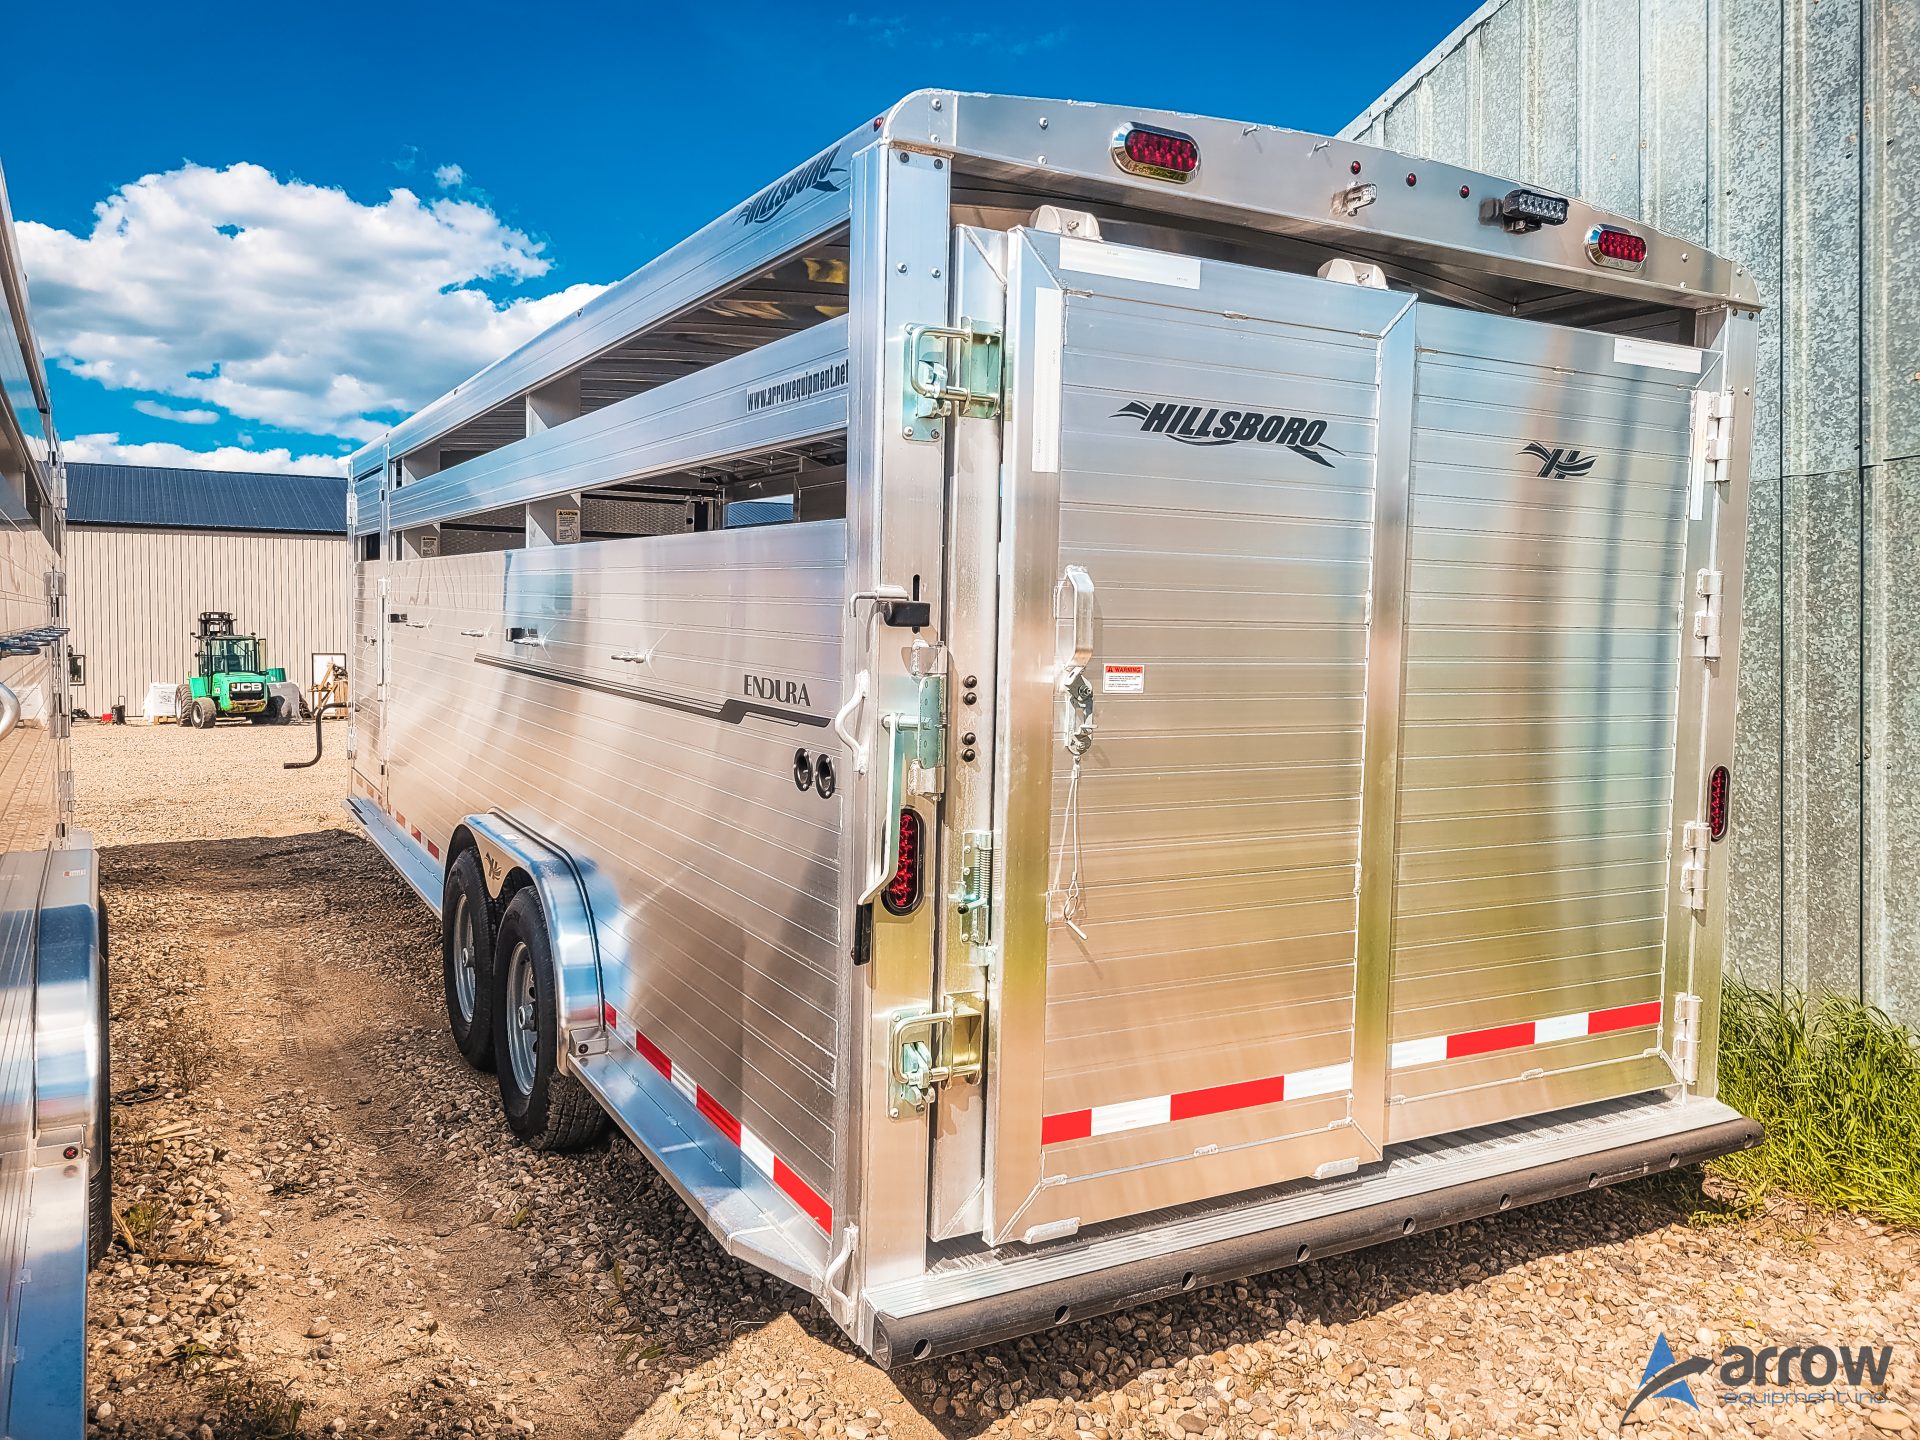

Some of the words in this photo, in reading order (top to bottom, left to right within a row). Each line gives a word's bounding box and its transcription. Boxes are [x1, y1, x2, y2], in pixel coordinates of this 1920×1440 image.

[747, 359, 849, 412] www.arrowequipment.net
[1140, 402, 1328, 447] HILLSBORO
[231, 683, 263, 691] JCB
[743, 674, 811, 706] ENDURA
